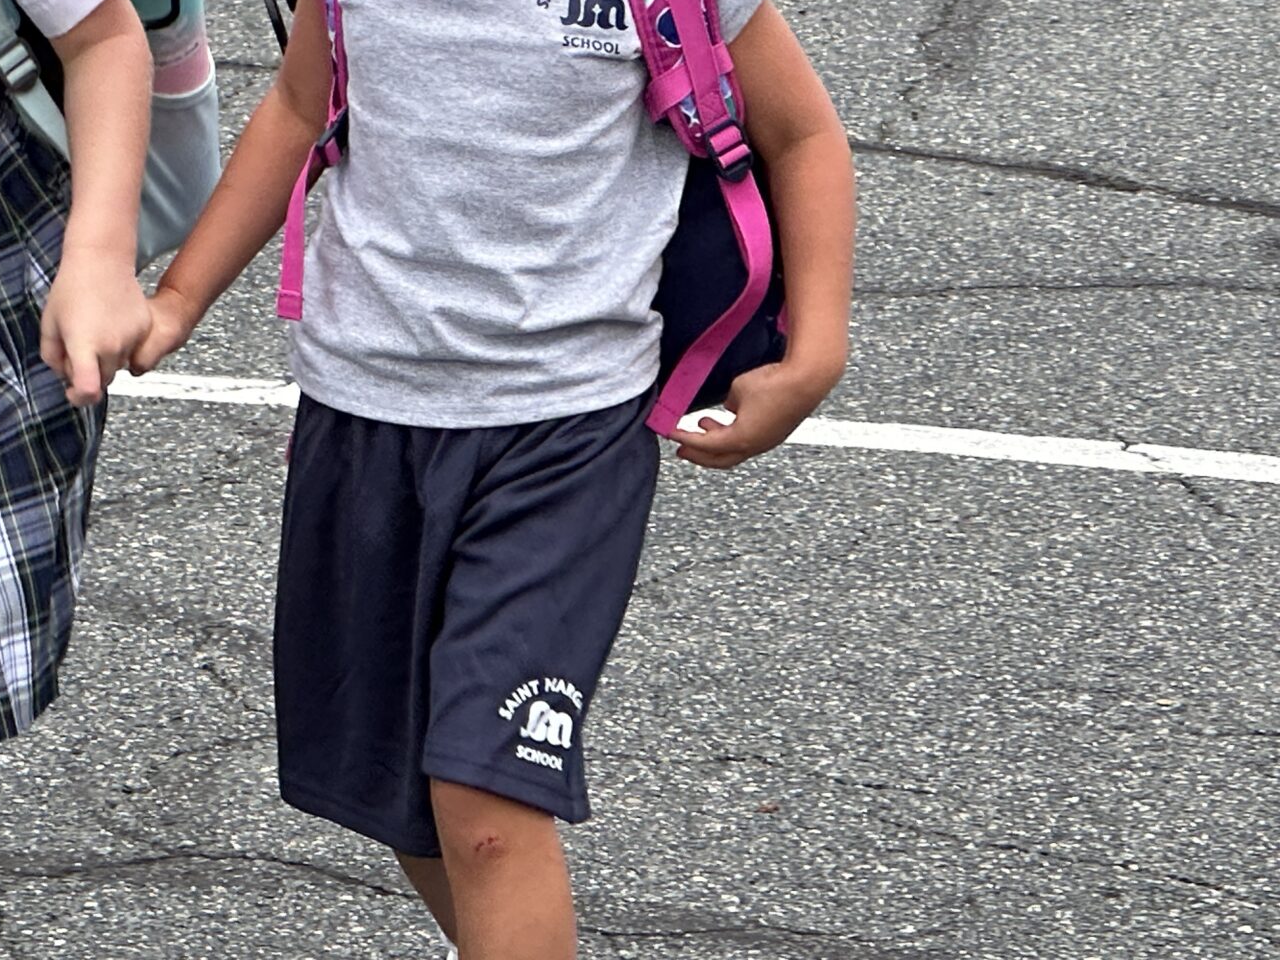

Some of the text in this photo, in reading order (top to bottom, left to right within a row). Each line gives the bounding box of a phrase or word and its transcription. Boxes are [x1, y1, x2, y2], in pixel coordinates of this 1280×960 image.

[562, 36, 621, 55] SCHOOL
[498, 678, 540, 721] SAINT
[515, 744, 564, 772] SCHOOL
